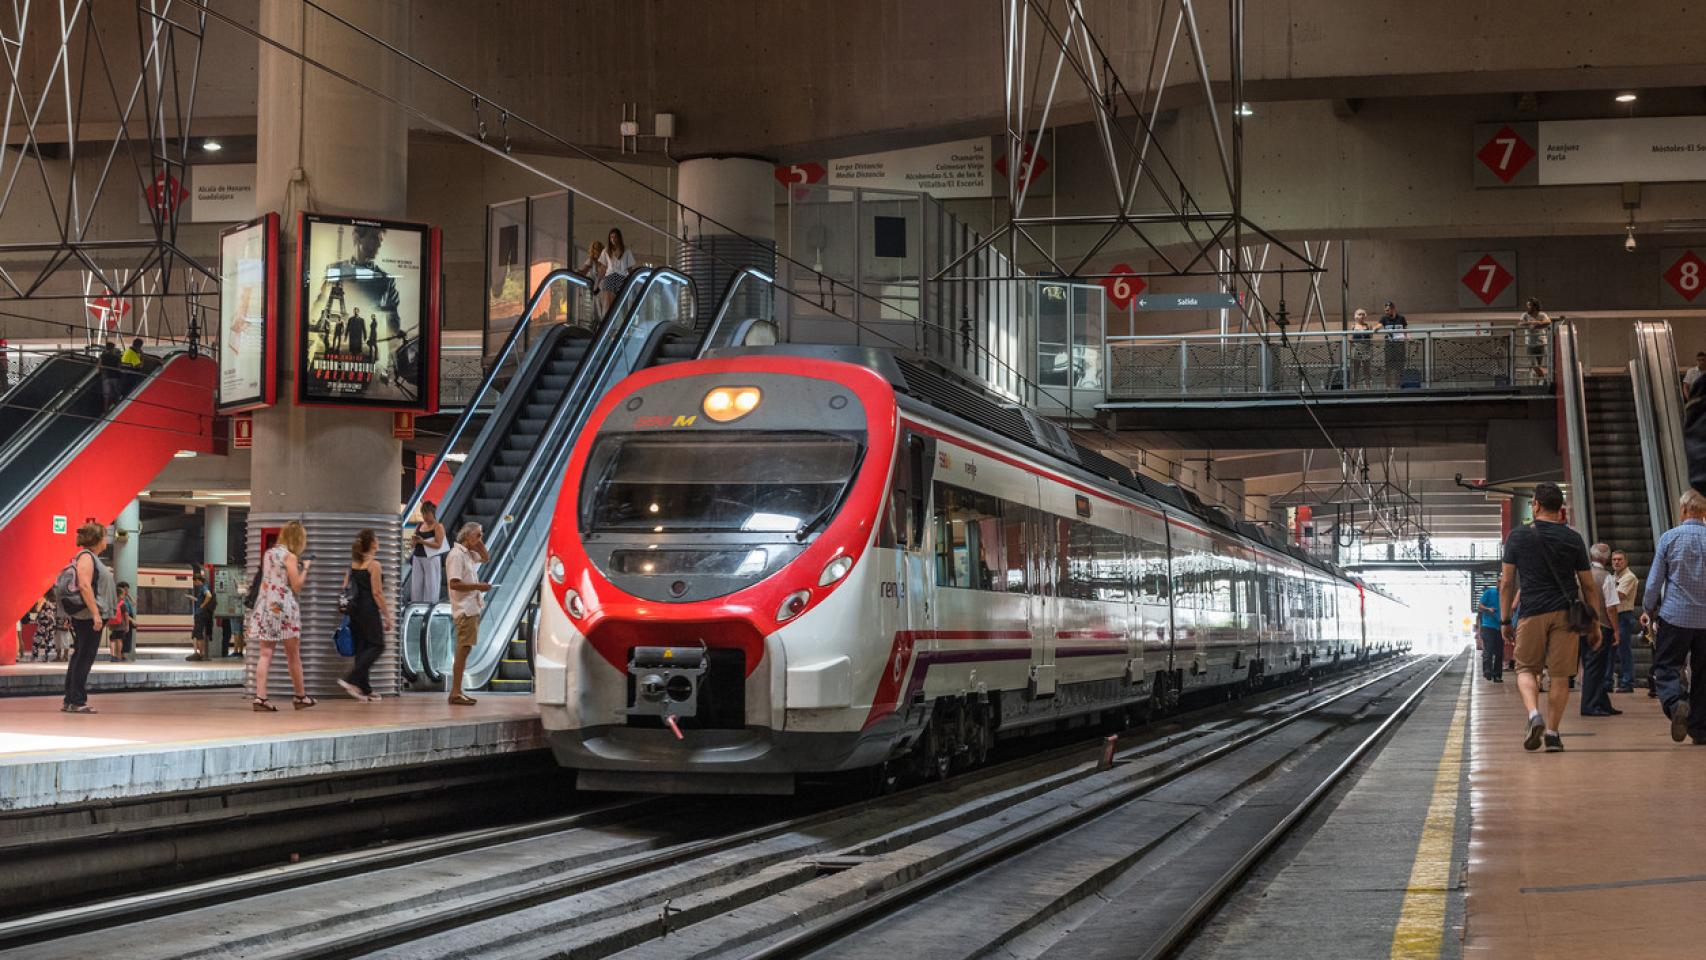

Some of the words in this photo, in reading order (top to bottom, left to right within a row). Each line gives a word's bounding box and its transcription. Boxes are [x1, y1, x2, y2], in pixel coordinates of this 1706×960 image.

[1546, 143, 1580, 153] Aranjuez
[1495, 138, 1516, 171] 7
[1546, 153, 1566, 161] Parla
[855, 162, 884, 170] Distancia
[936, 163, 966, 171] Colmenar
[968, 163, 984, 172] Viejo
[956, 179, 984, 187] Escorial
[226, 184, 251, 193] Henares
[198, 193, 234, 201] Guadalajara
[1478, 264, 1497, 294] 7
[1679, 262, 1699, 291] 8
[1113, 273, 1130, 299] 6
[1177, 298, 1198, 306] Salida
[880, 572, 905, 608] renfe
